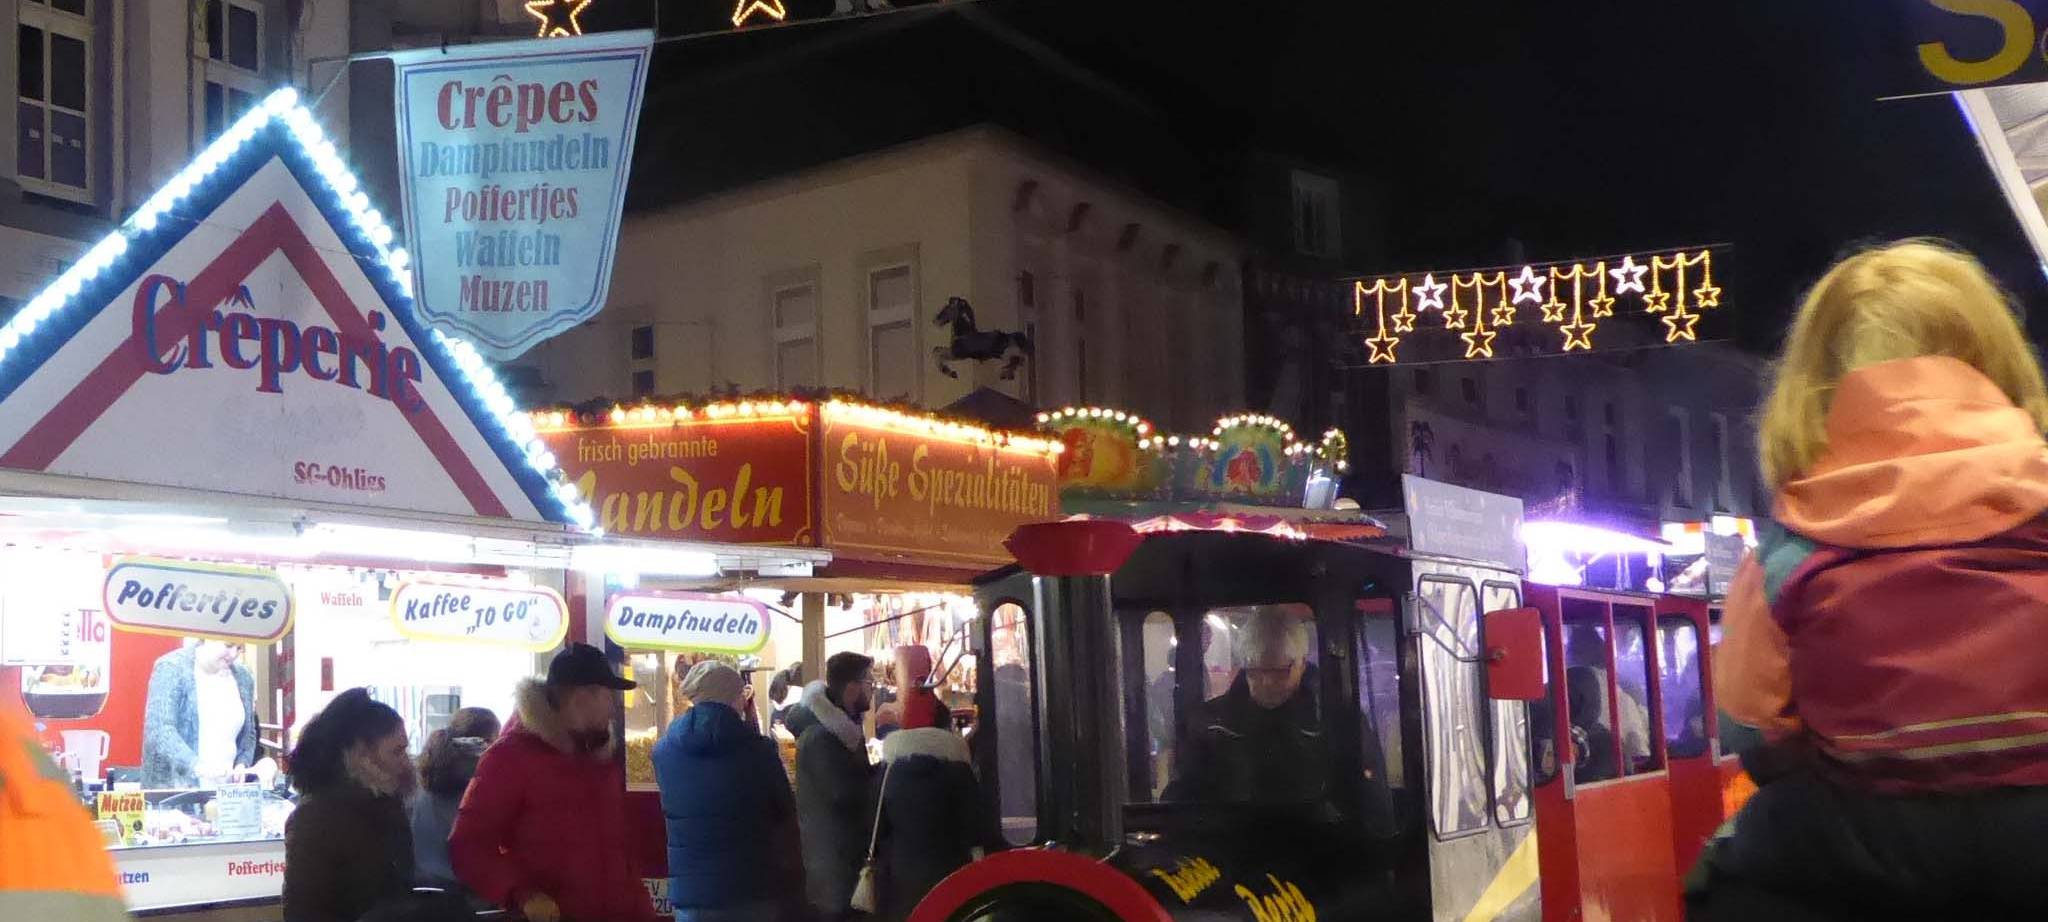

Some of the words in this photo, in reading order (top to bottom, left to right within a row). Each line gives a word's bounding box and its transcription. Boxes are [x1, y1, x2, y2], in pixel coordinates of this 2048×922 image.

[437, 74, 598, 133] Crêpes
[418, 132, 609, 179] Dampfnudeln
[444, 182, 579, 225] Poffertjes
[456, 229, 561, 268] Waffeln
[458, 275, 549, 313] Muzen
[132, 273, 422, 414] Crêperie
[577, 435, 622, 463] frisch
[627, 433, 718, 467] gebrannte
[294, 460, 387, 492] SG-Ohligs
[836, 431, 900, 511] Süße
[908, 443, 1049, 517] Spezialitäten
[117, 579, 278, 624] Poffertjes
[320, 591, 363, 607] Waffeln
[405, 592, 471, 622] Kaffee
[77, 609, 105, 643] lla
[617, 606, 759, 635] Dampfnudeln
[227, 859, 286, 877] Poffertjes
